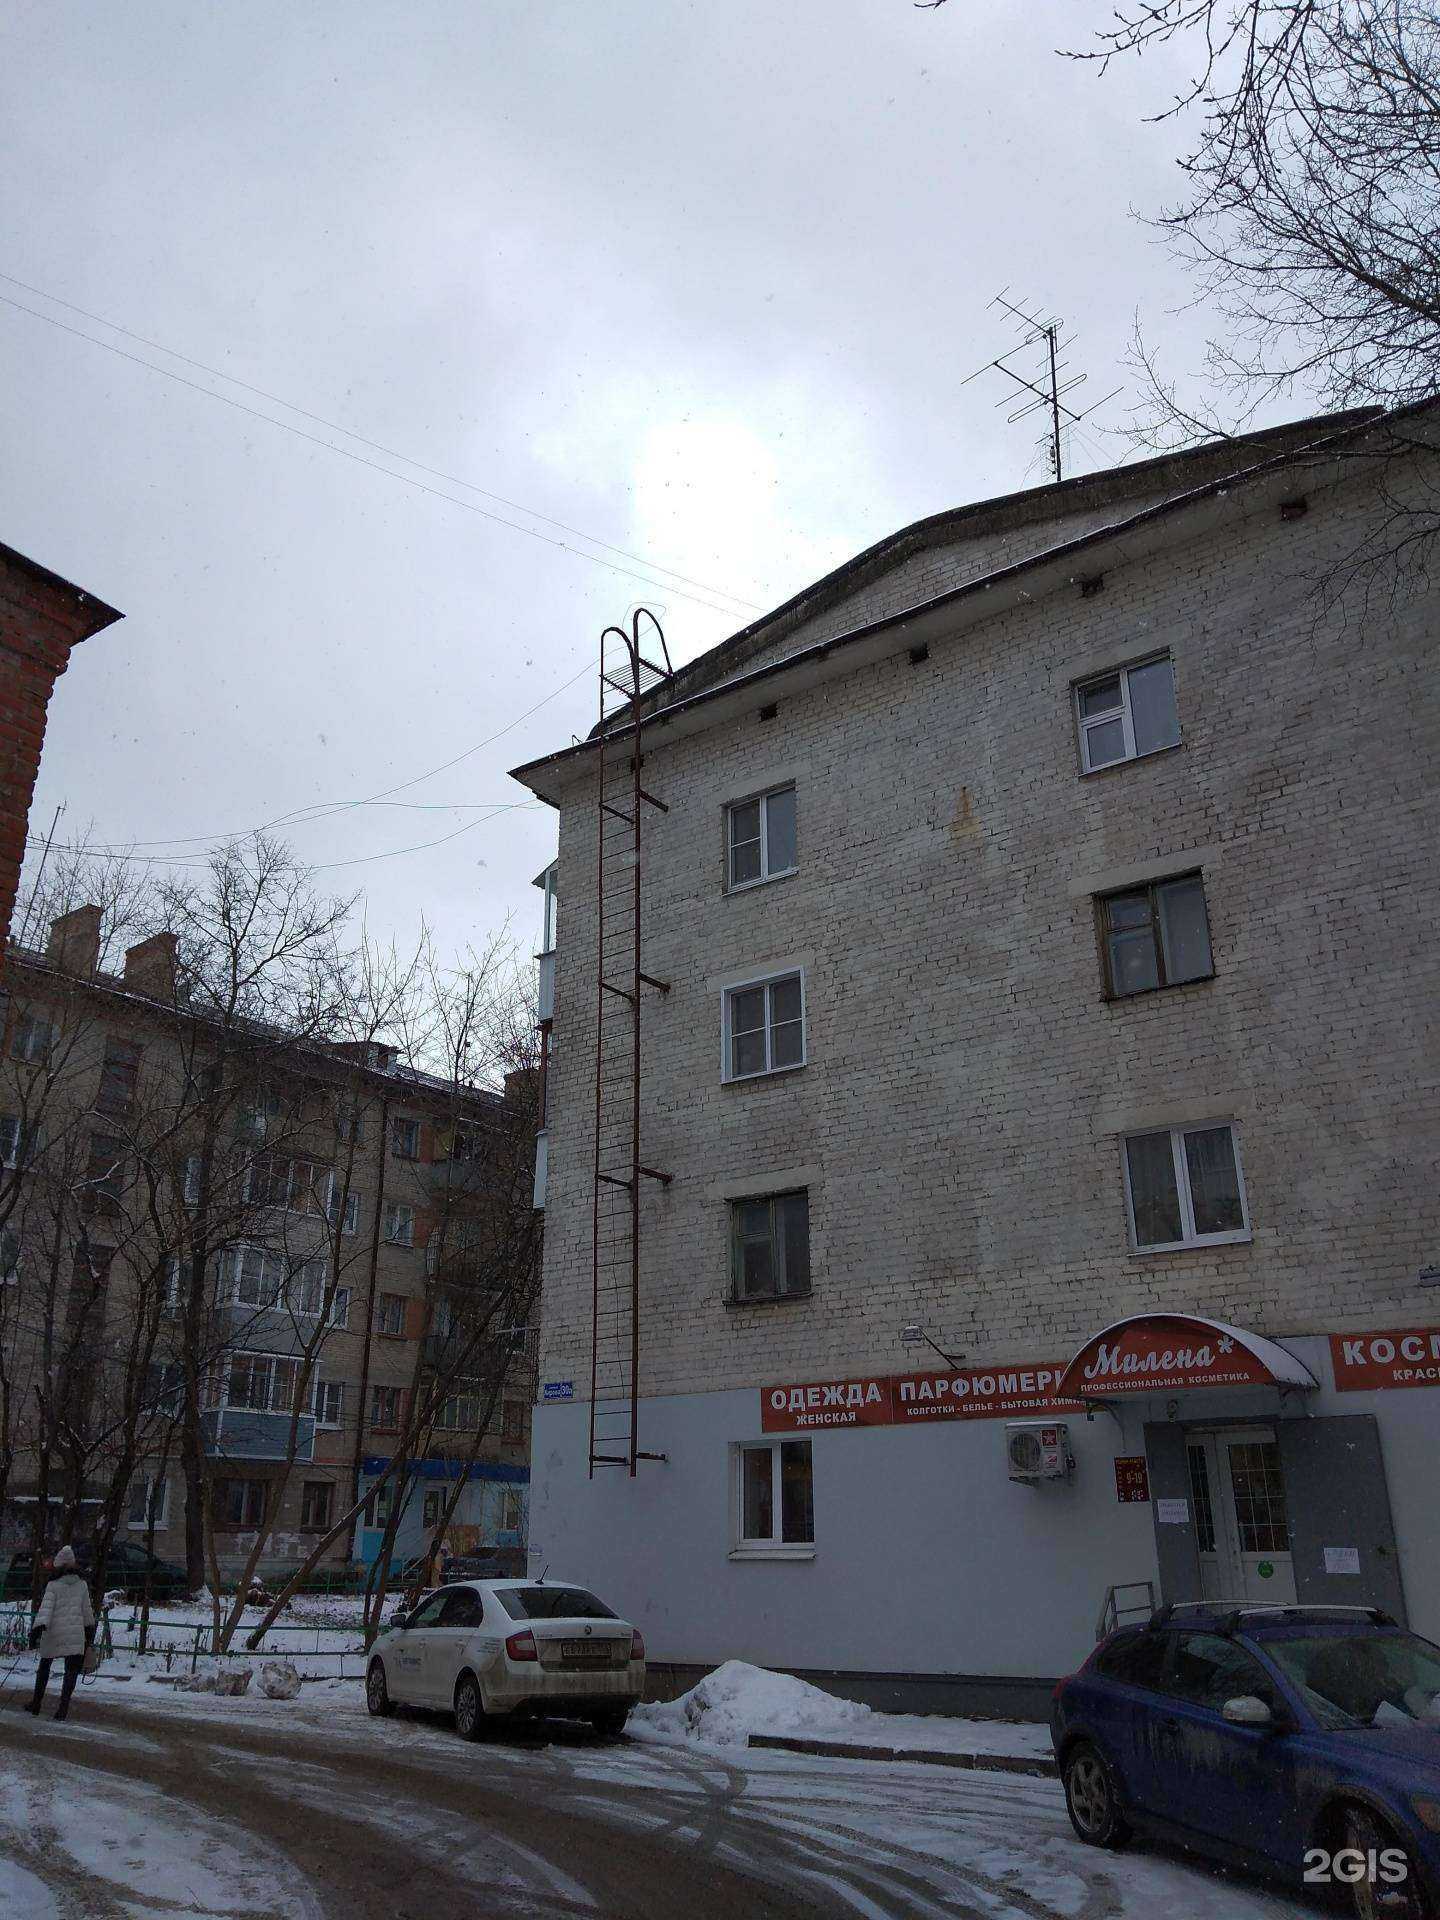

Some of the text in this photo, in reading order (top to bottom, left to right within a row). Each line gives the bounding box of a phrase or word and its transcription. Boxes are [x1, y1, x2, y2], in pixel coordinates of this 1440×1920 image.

[1084, 1344, 1215, 1379] Милена
[1081, 1372, 1250, 1392] ПРОФЕССИОНАЛЬНАЯ КОСМЕТИКА
[1392, 1367, 1440, 1381] КРАС
[770, 1383, 882, 1412] ОДЕЖДА
[907, 1406, 955, 1416] КОЛГОТКИ
[962, 1404, 993, 1413] БЕЛЬЕ
[1001, 1398, 1048, 1410] БЫТОВАЯ
[796, 1412, 857, 1426] ЖЕНСКАЯ
